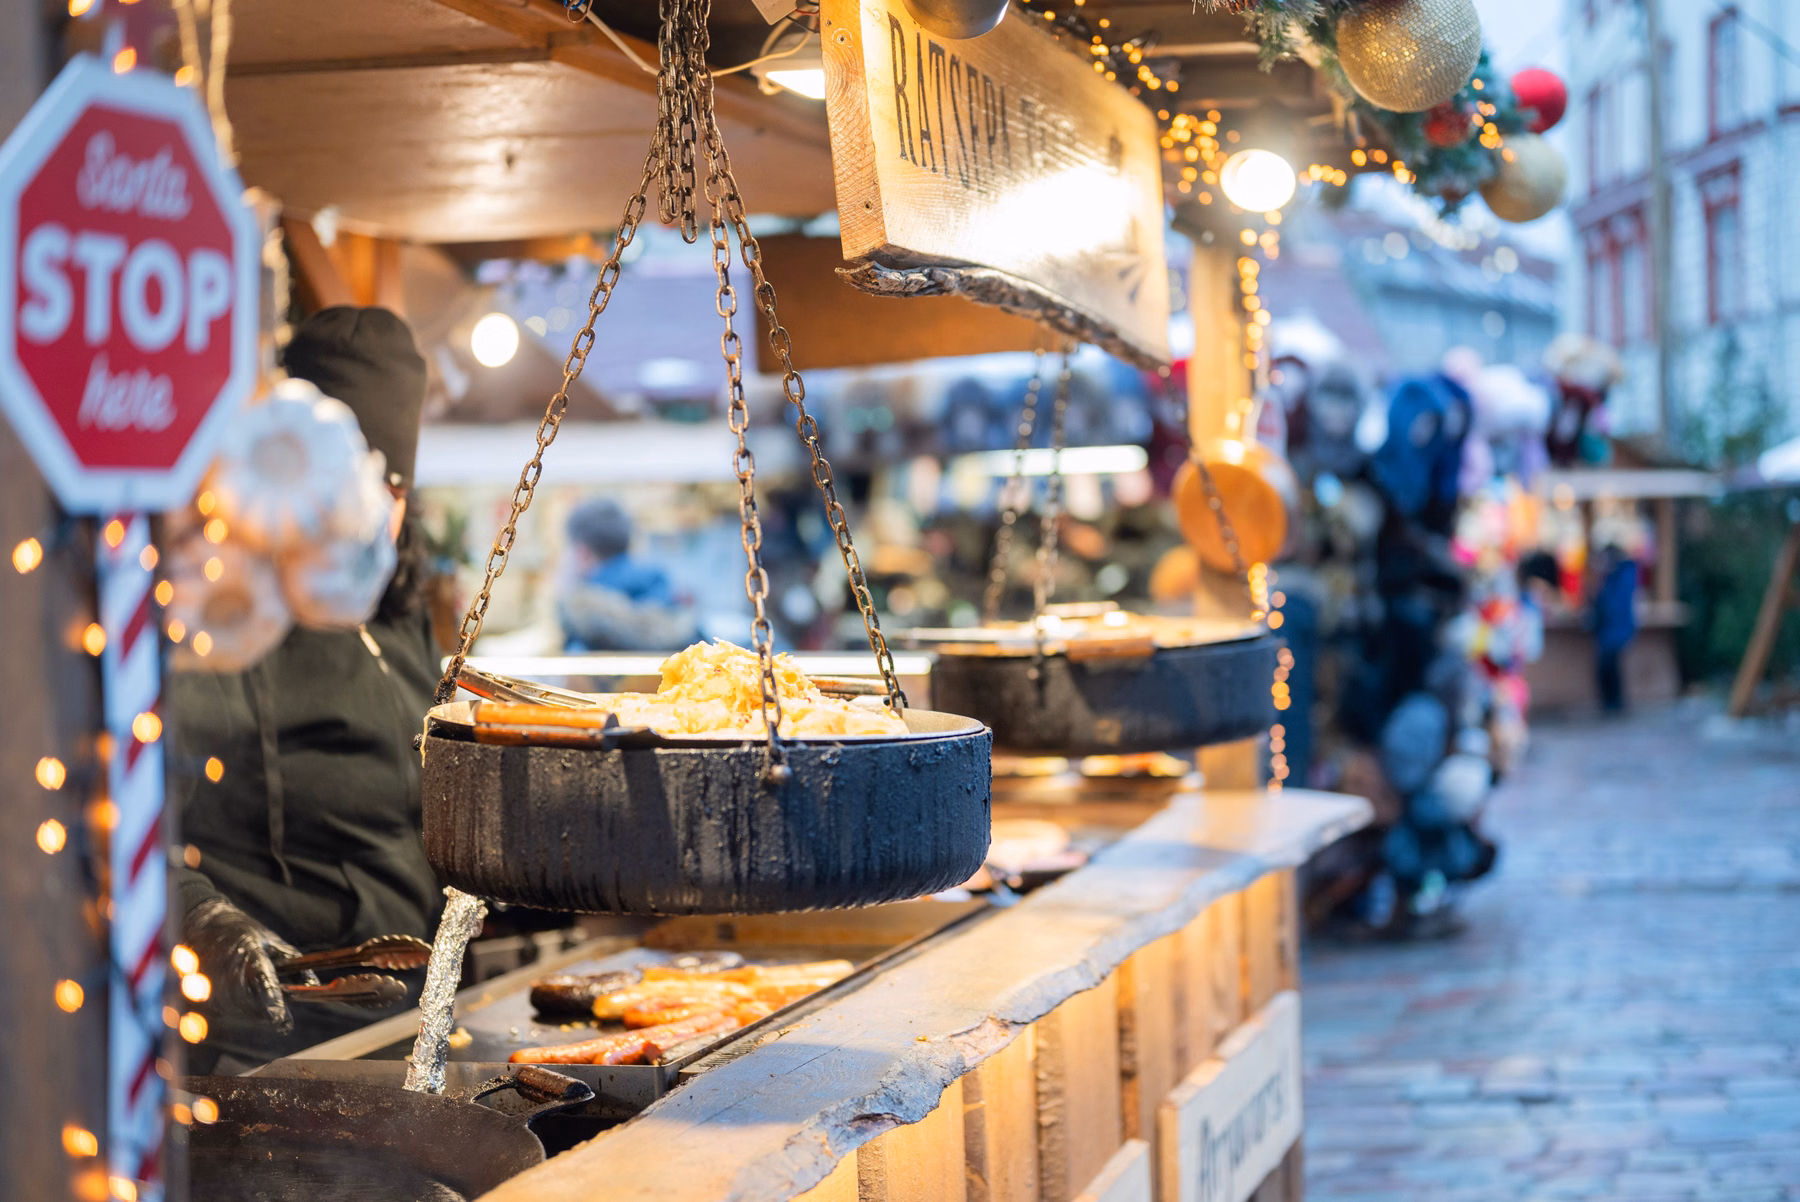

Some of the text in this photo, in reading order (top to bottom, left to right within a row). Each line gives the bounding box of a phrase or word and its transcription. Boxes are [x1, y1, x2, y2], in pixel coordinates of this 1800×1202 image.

[76, 130, 191, 222] Santa
[18, 222, 232, 354] STOP
[78, 352, 178, 432] here
